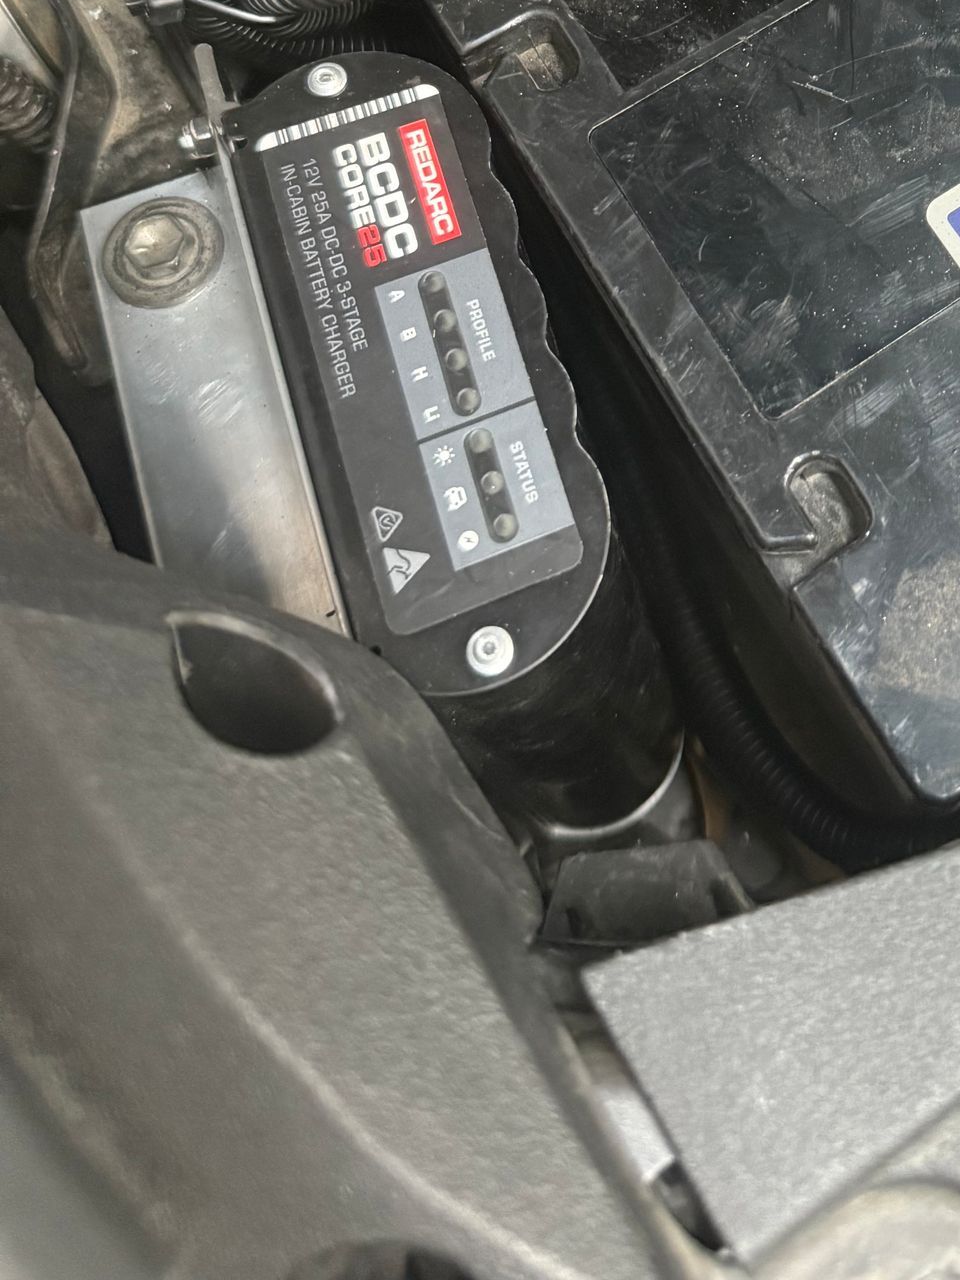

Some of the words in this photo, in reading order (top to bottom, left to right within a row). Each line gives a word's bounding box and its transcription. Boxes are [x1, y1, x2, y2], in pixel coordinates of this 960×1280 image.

[301, 158, 322, 186] 12V
[358, 134, 417, 257] BCDC
[408, 130, 452, 234] REDARC
[311, 191, 331, 223] 25A
[333, 143, 386, 268] CORE25
[280, 164, 311, 234] IN-CABIN
[300, 238, 331, 308] BATTERY
[322, 314, 356, 397] CHARGER
[321, 226, 347, 278] DC-DC
[337, 281, 368, 351] 3-STAGE
[388, 288, 405, 302] A
[400, 327, 416, 341] B
[466, 299, 495, 361] PROFILE
[411, 366, 428, 381] H
[510, 442, 538, 503] STATUS
